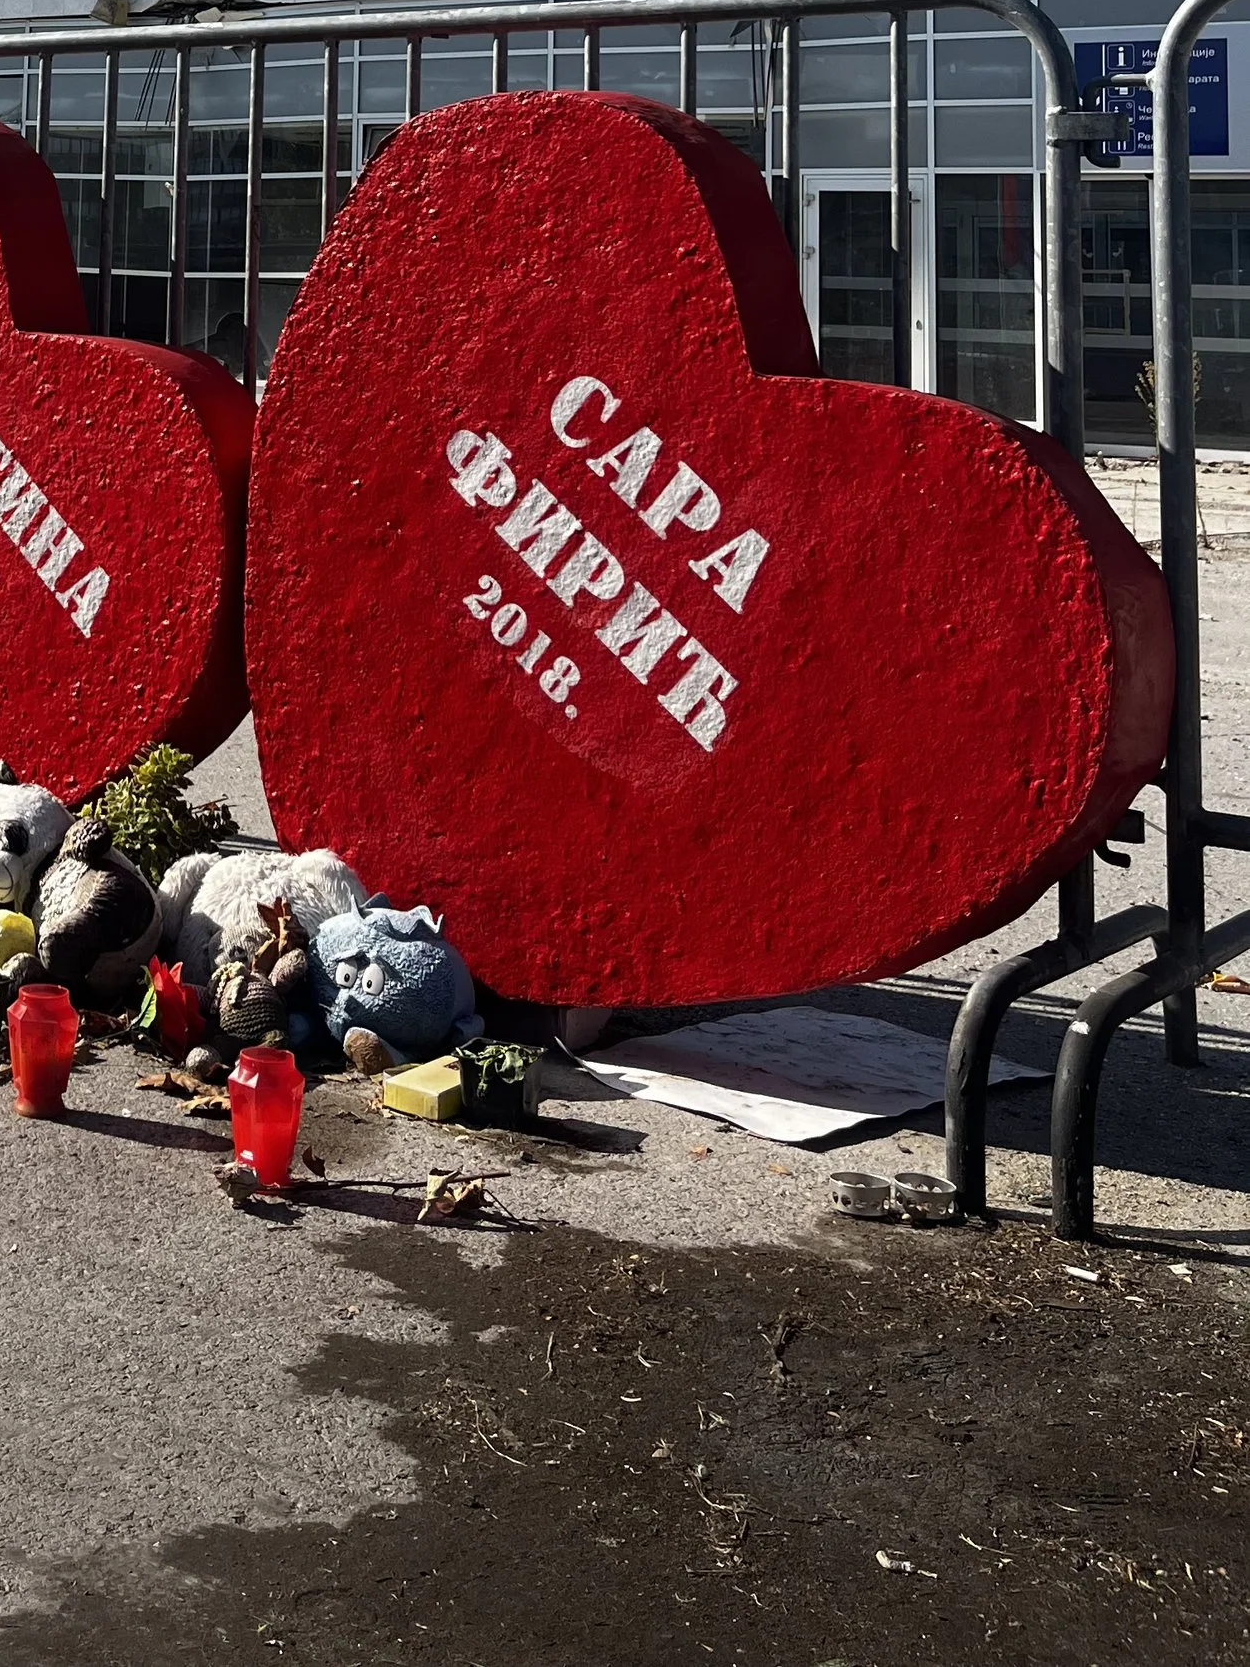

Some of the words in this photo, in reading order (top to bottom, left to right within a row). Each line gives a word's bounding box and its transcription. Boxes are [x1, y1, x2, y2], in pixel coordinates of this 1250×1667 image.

[1188, 75, 1220, 86] арата
[445, 429, 740, 753] ФИРИЋ
[549, 375, 771, 615] САРА
[462, 574, 582, 720] 2018.
